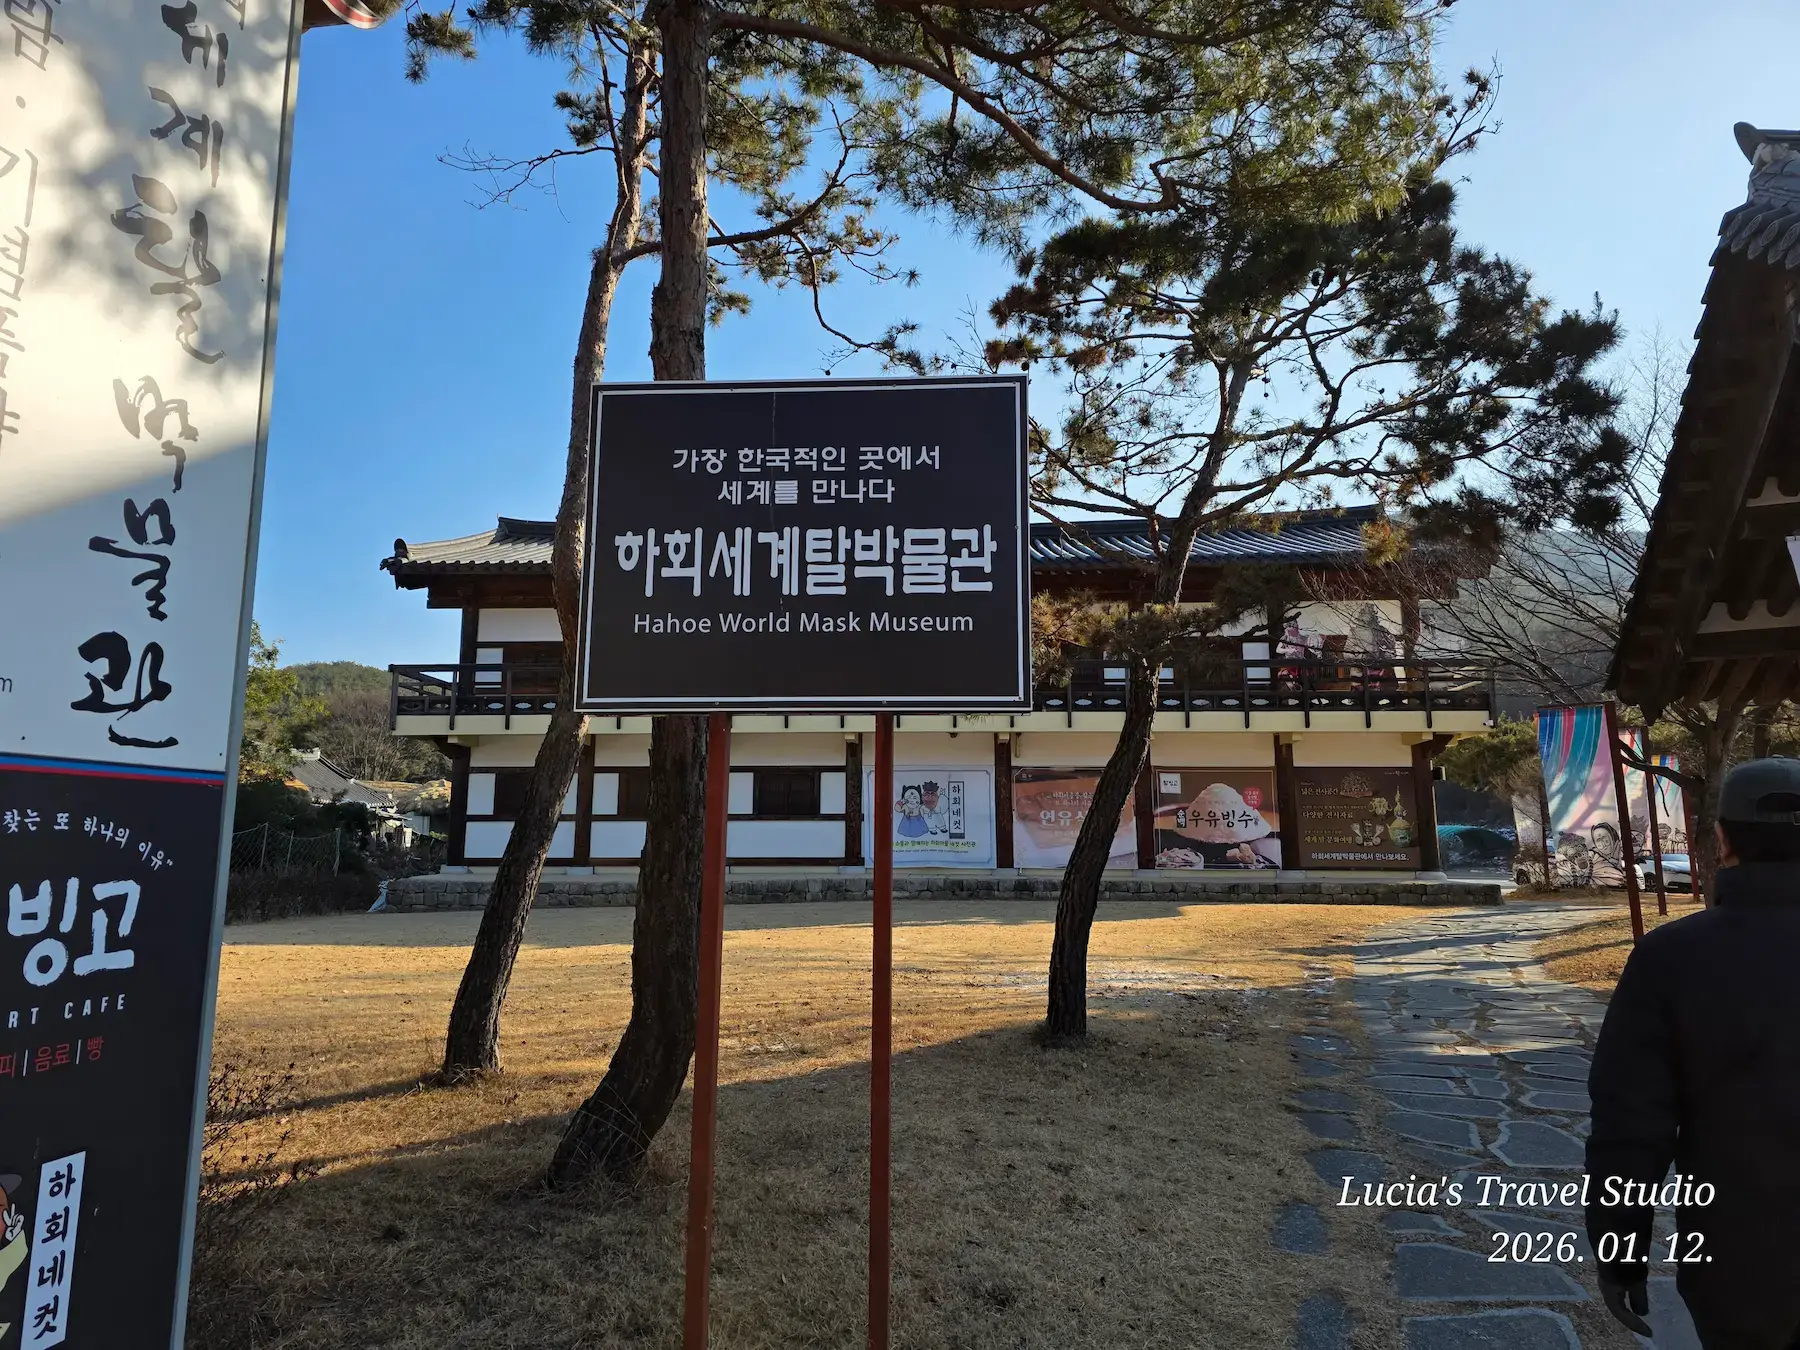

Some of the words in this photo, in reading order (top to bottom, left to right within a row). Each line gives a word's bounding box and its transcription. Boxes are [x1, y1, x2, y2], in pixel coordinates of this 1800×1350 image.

[69, 0, 245, 749] 세계탈박물관
[672, 447, 728, 474] 가장
[737, 446, 847, 473] 한국적인
[858, 445, 941, 471] 곳에서
[717, 479, 799, 505] 세계를
[812, 478, 896, 504] 만나다
[614, 523, 998, 598] 하회세계탈박물관
[634, 613, 712, 634] Hahoe
[719, 612, 790, 633] World
[799, 611, 861, 633] Mask
[869, 611, 974, 633] Museum
[951, 784, 962, 831] 하회네컷
[1188, 809, 1254, 829] 우유빙수
[2, 808, 41, 833] 찾는
[53, 811, 70, 831] 또
[83, 815, 130, 849] 하나의
[6, 876, 141, 987] 빙고
[64, 993, 126, 1020] CAFE
[34, 1043, 72, 1073] 음료
[87, 1035, 104, 1061] 빵
[32, 1162, 77, 1341] 하회네컷
